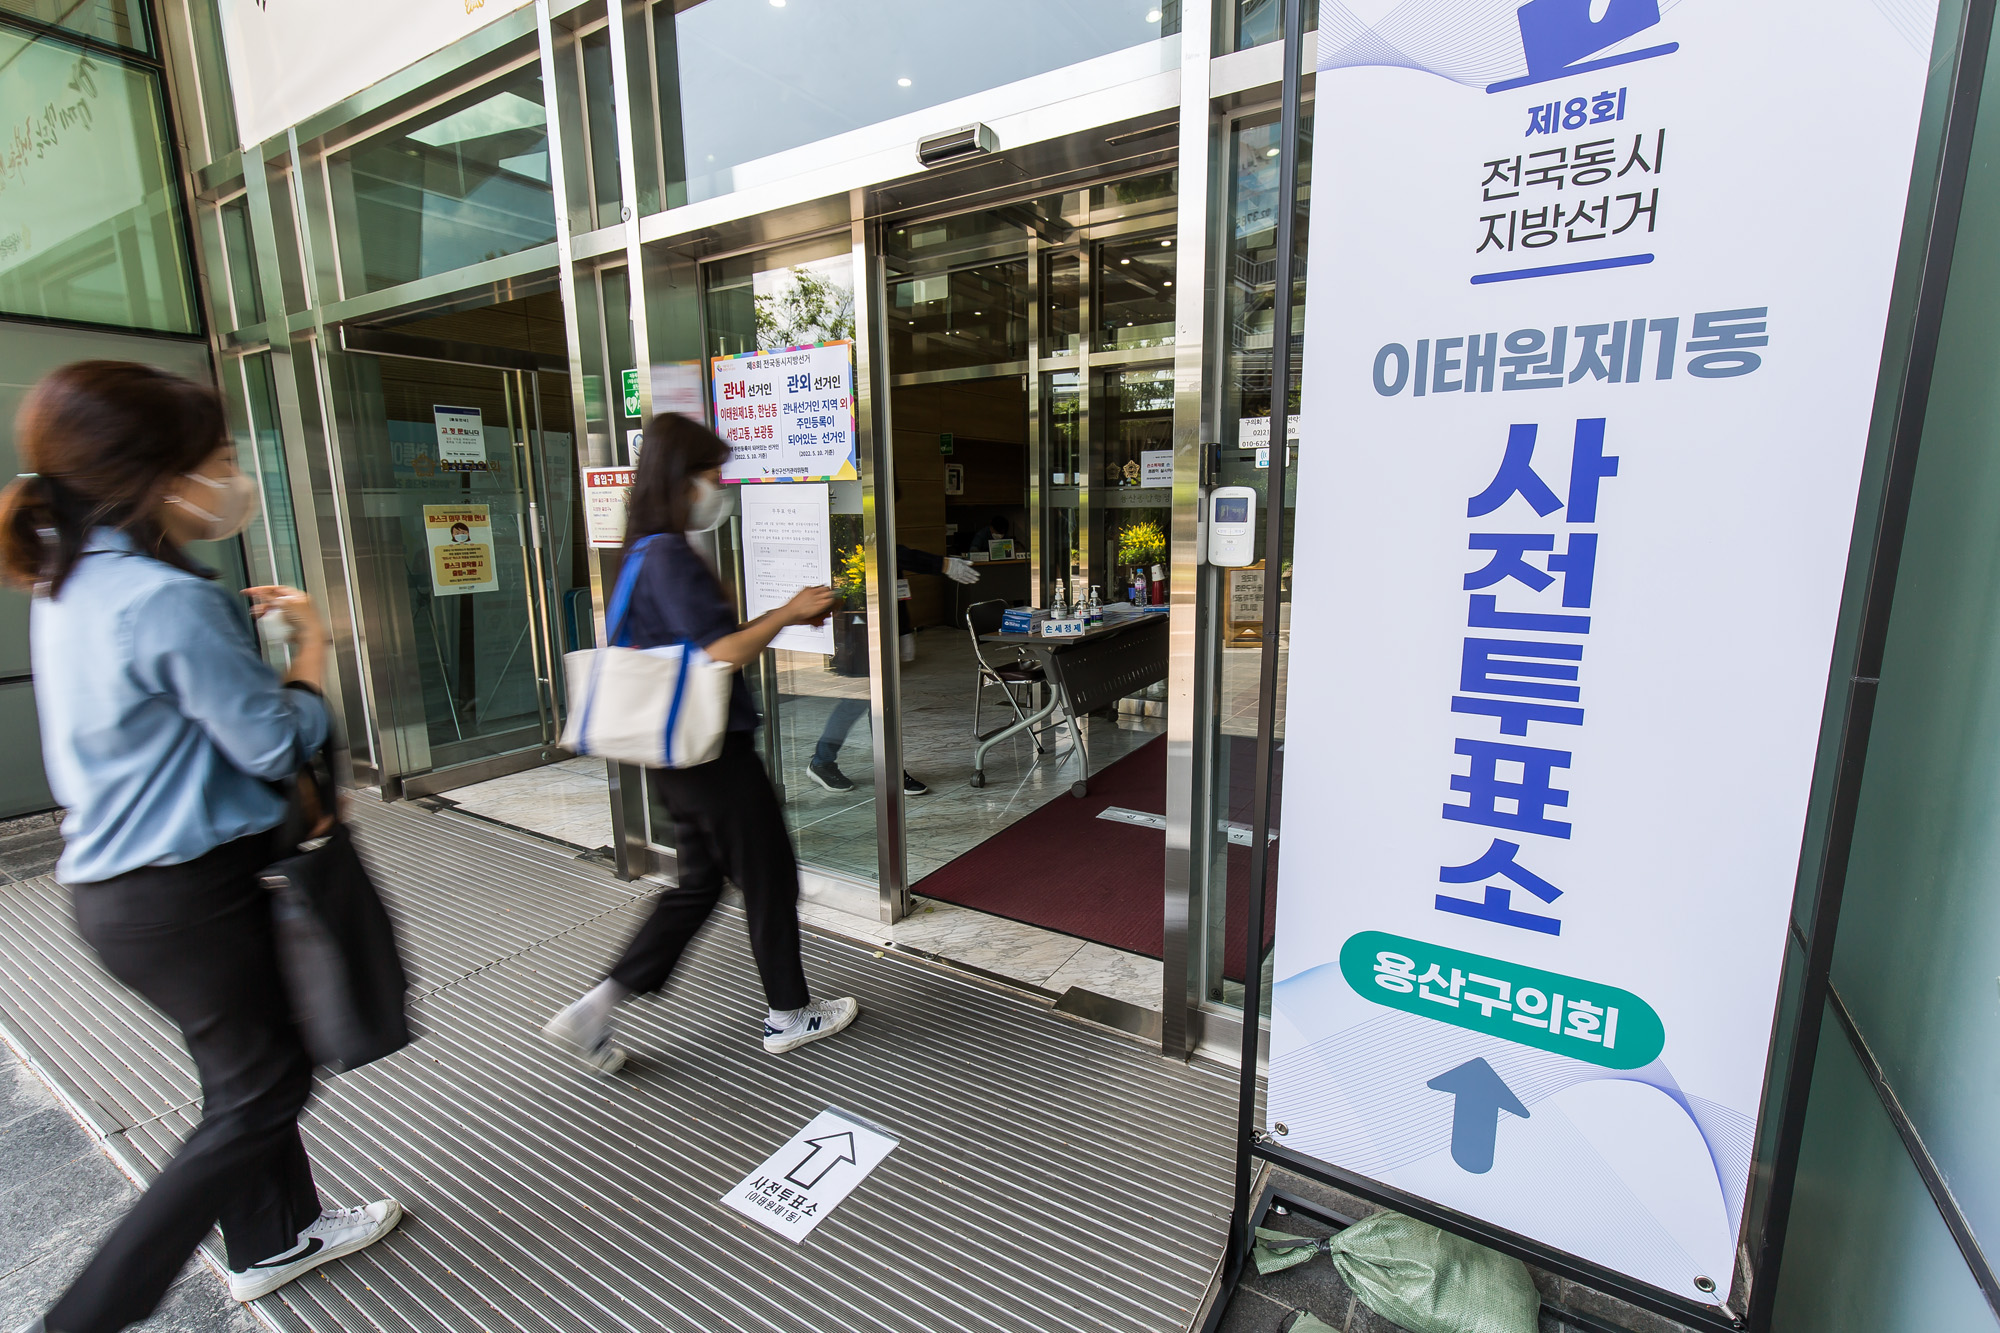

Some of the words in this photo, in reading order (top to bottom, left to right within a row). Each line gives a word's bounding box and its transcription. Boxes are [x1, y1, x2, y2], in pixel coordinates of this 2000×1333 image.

[1525, 87, 1628, 138] 제8회
[1481, 128, 1667, 202] 전국동시
[1476, 188, 1660, 254] 지방선거
[1373, 306, 1770, 397] 이태원제1동
[746, 359, 762, 370] 제8회
[763, 353, 811, 369] 전국동시지방선거
[723, 380, 746, 400] 관내
[747, 382, 773, 397] 선거인
[787, 373, 812, 394] 관외
[814, 374, 841, 391] 선거인
[720, 405, 757, 422] 이태원제1동,
[757, 403, 778, 419] 한남동
[782, 400, 820, 415] 관내선거인
[821, 399, 839, 412] 지역
[839, 397, 848, 410] 외
[796, 415, 835, 430] 주민등록이
[726, 425, 753, 442] 서빙고동,
[753, 424, 774, 440] 보광동
[787, 433, 818, 446] 되어있는
[821, 431, 846, 444] 선거인
[593, 473, 614, 485] 출입구
[429, 515, 448, 523] 마스크
[1045, 625, 1082, 633] 손세정제
[1434, 417, 1620, 937] 사전투표소
[1373, 950, 1619, 1049] 용산구의회
[806, 1016, 822, 1032] N
[749, 1175, 819, 1218] 사전투표소
